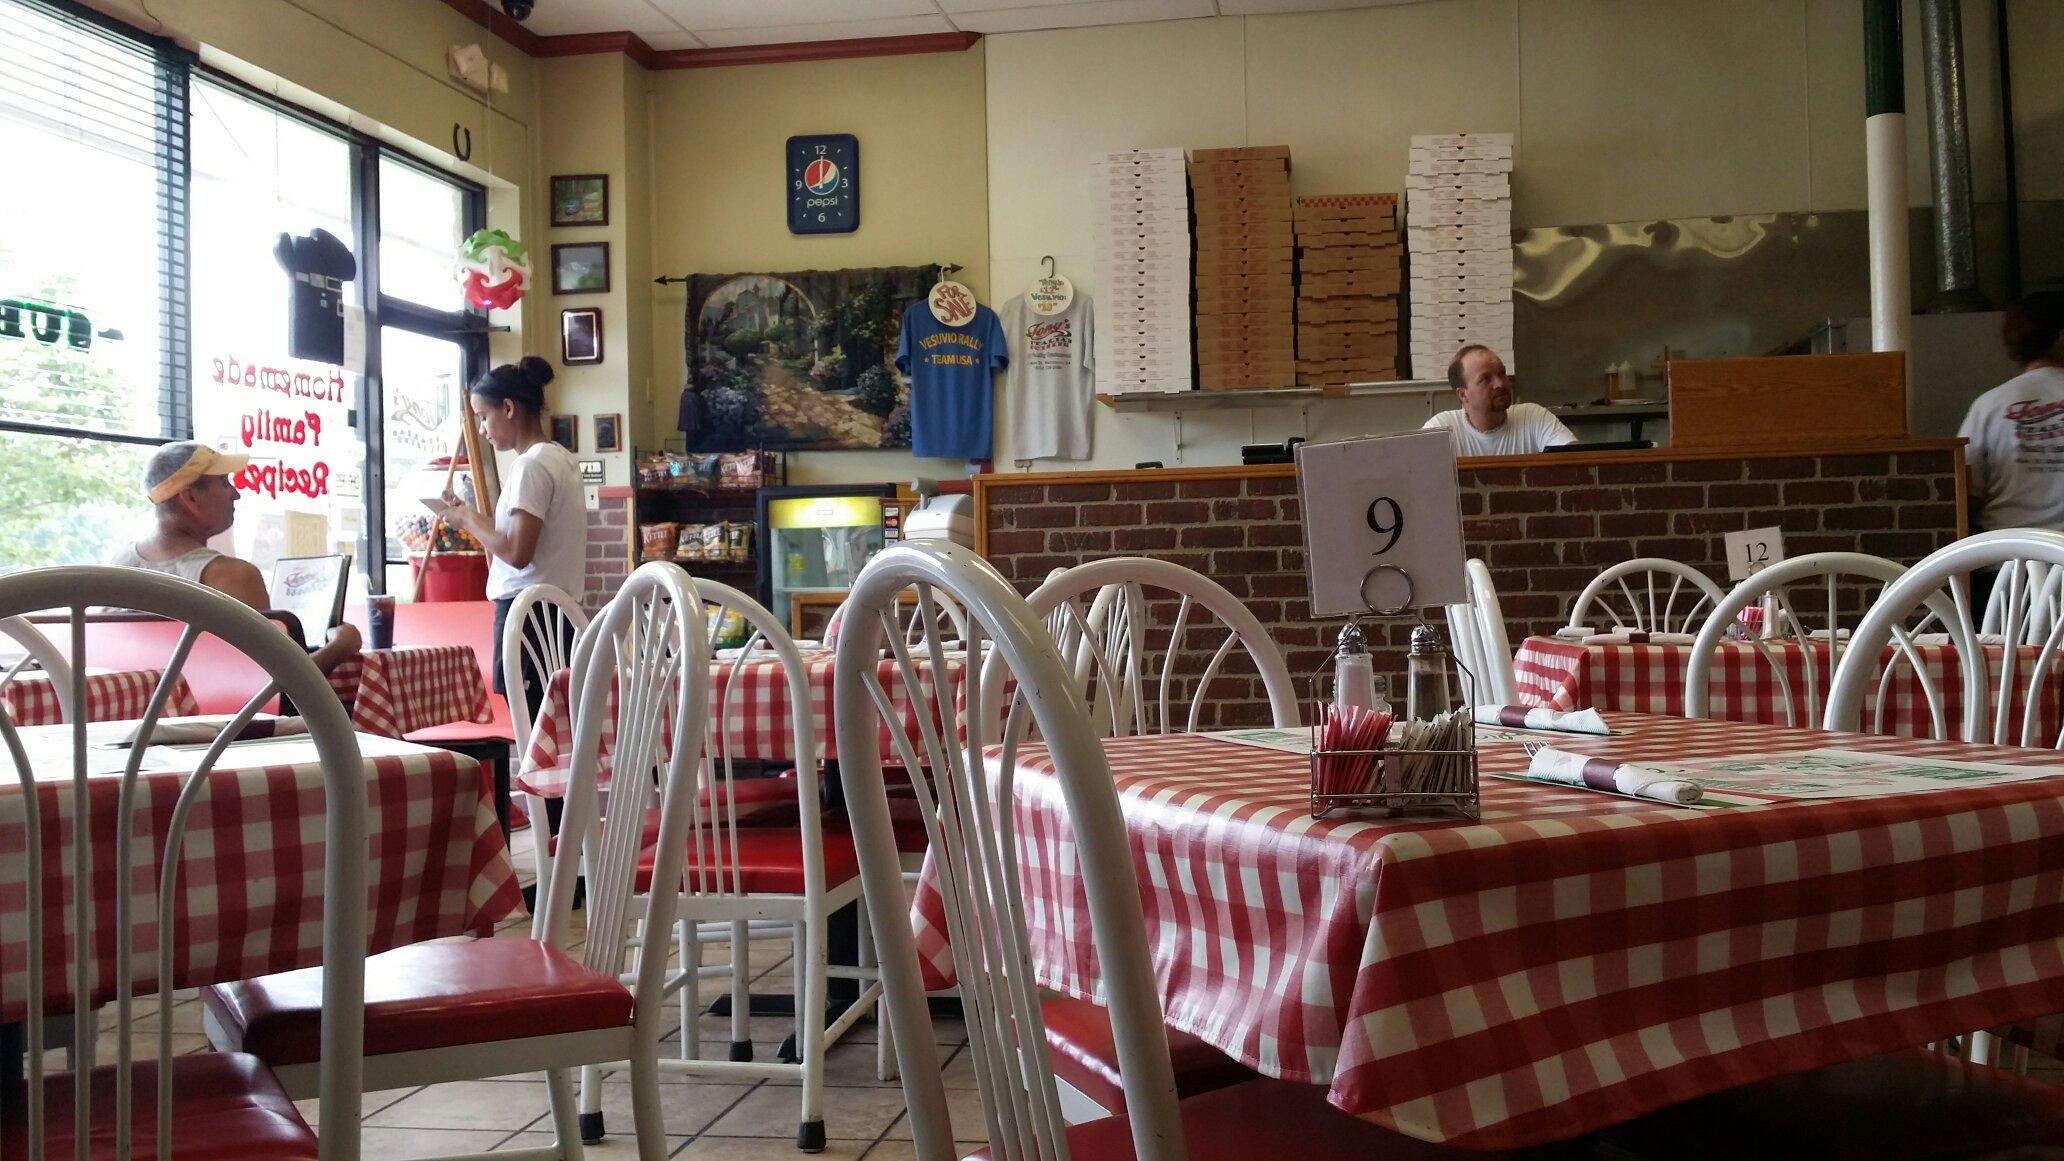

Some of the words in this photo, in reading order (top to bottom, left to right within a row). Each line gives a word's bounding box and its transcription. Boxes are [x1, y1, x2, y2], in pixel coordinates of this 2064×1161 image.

[815, 145, 827, 154] 12
[795, 180, 802, 190] 9
[841, 178, 848, 188] 3
[806, 196, 838, 208] pepsi
[817, 212, 826, 222] 6
[936, 284, 967, 299] FOR
[933, 298, 974, 322] SALE
[919, 332, 957, 349] VESUVIO
[959, 334, 984, 351] RALLY
[931, 354, 955, 364] TEAM
[956, 354, 973, 365] USA
[1367, 497, 1404, 556] 9
[1746, 542, 1769, 562] 12
